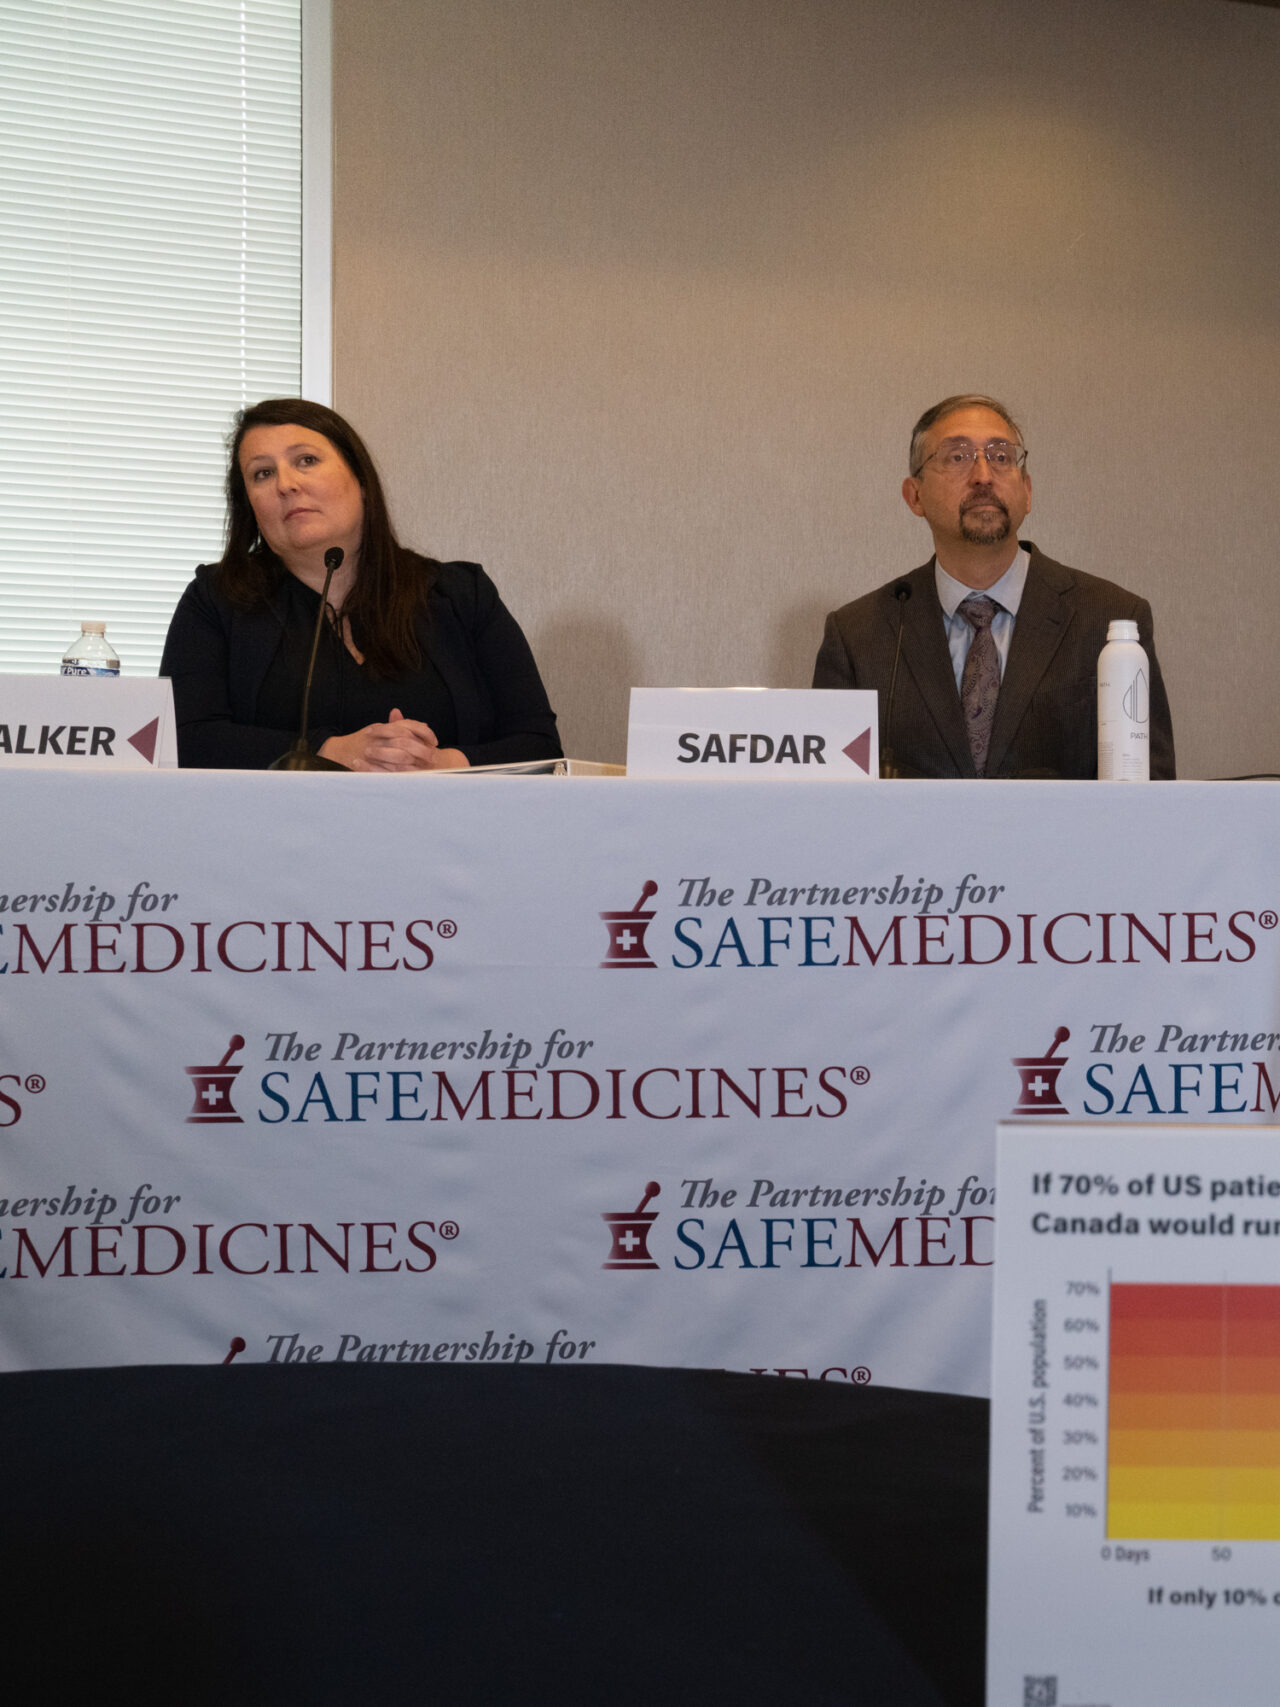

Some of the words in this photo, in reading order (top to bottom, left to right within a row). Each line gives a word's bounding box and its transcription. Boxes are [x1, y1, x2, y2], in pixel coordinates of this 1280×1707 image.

[677, 733, 826, 764] SAFDAR
[119, 881, 179, 922] for
[676, 877, 733, 907] The
[744, 874, 944, 914] Partnership
[947, 874, 1005, 915] for
[0, 918, 458, 975] MEDICINES®
[672, 909, 1279, 969] SAFEMEDICINES®
[264, 1031, 322, 1063] The
[331, 1029, 533, 1068] Partnership
[535, 1029, 595, 1069] for
[1089, 1023, 1145, 1055] The
[257, 1065, 871, 1125] SAFEMEDICINES®
[680, 1178, 737, 1208] The
[746, 1176, 946, 1216] Partnership
[1032, 1173, 1053, 1196] If
[1059, 1174, 1120, 1197] 70%
[1127, 1174, 1156, 1196] of
[1164, 1175, 1202, 1197] US
[120, 1184, 181, 1224] for
[1031, 1212, 1139, 1235] Canada
[1149, 1214, 1235, 1236] would
[0, 1220, 460, 1279] MEDICINES®
[1066, 1281, 1100, 1296] 70%
[1063, 1318, 1099, 1333] 60%
[265, 1333, 324, 1363] The
[336, 1331, 535, 1364] Partnership
[545, 1329, 595, 1364] for
[1030, 1298, 1050, 1389] population
[1063, 1355, 1099, 1371] 50%
[1028, 1391, 1046, 1425] U.S.
[1062, 1392, 1099, 1408] 40%
[1027, 1427, 1045, 1446] of
[1063, 1430, 1098, 1446] 30%
[1026, 1448, 1045, 1514] Percent
[1062, 1466, 1097, 1482] 20%
[1065, 1504, 1097, 1519] 10%
[1100, 1546, 1112, 1562] 0
[1115, 1546, 1150, 1565] Days
[1211, 1547, 1232, 1562] 50
[1148, 1587, 1164, 1606] If
[1169, 1587, 1217, 1611] only
[1223, 1588, 1267, 1607] 10%
